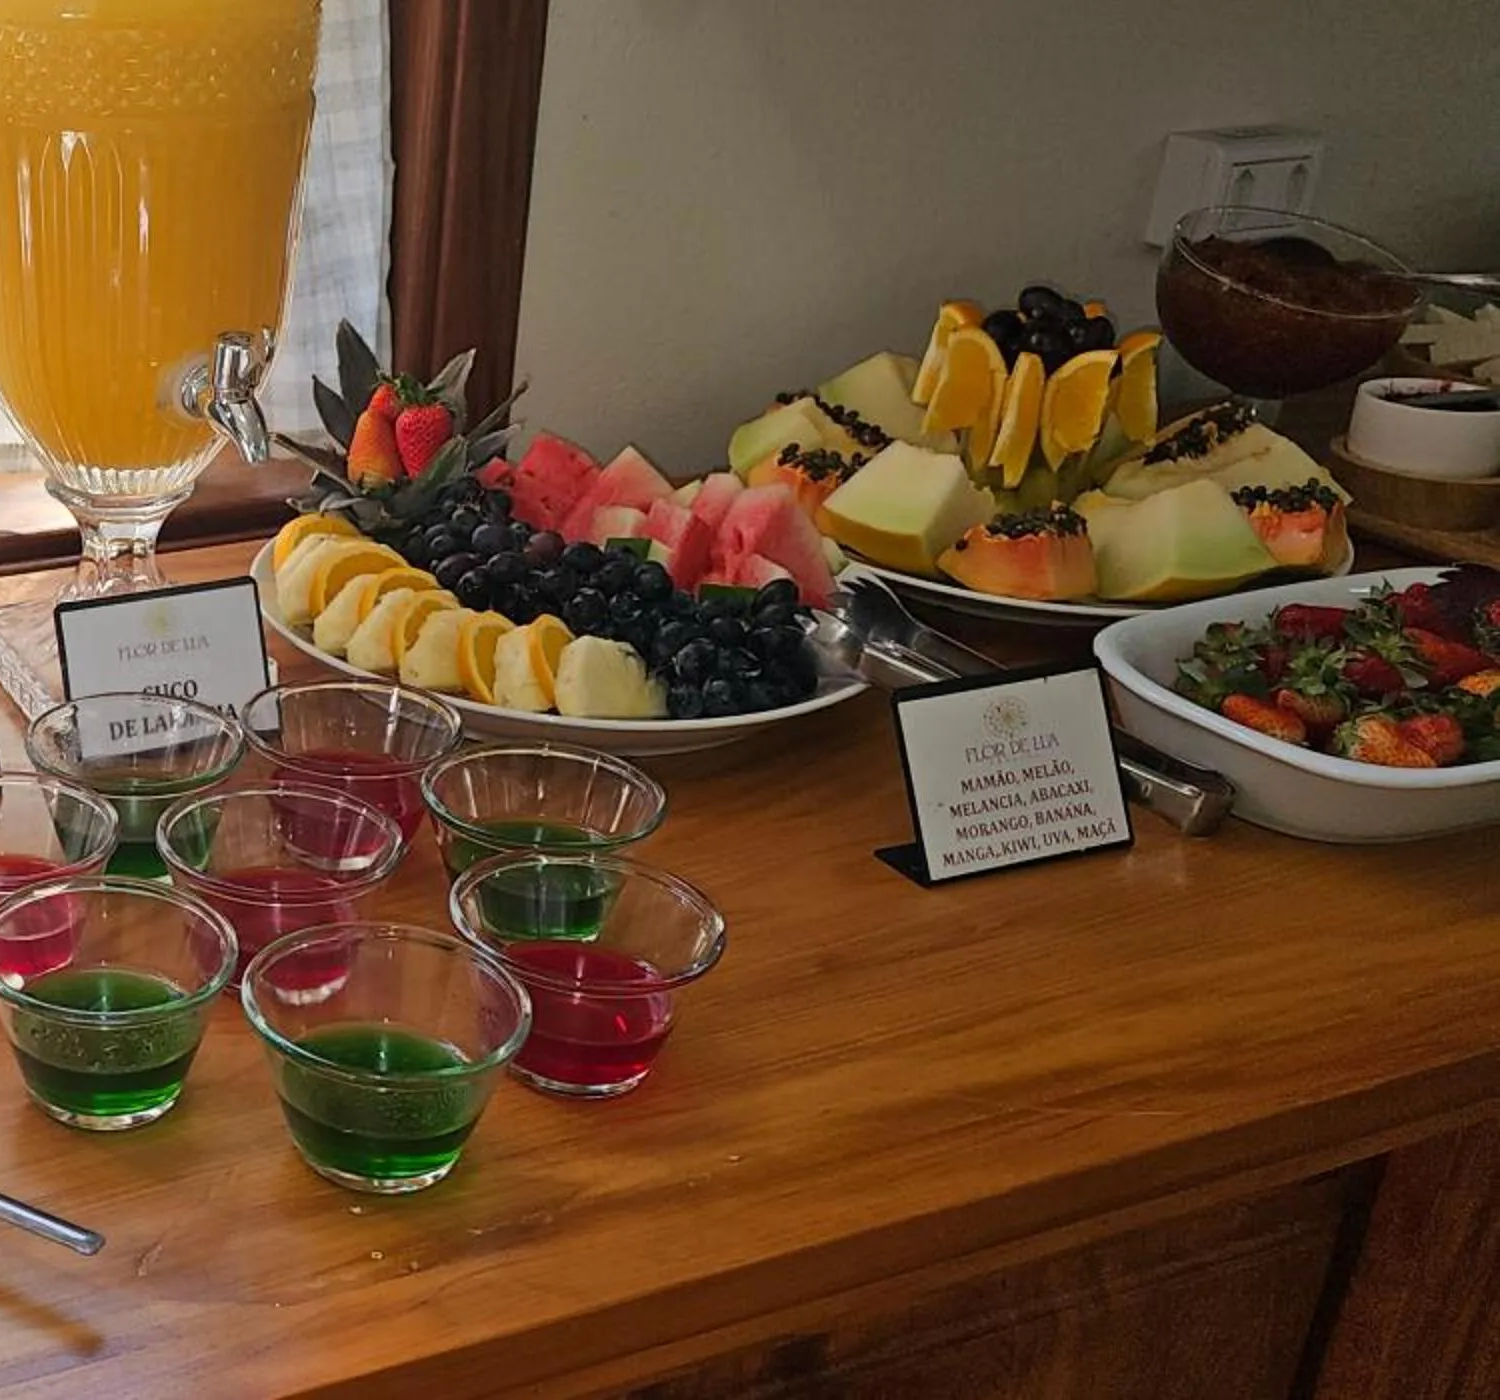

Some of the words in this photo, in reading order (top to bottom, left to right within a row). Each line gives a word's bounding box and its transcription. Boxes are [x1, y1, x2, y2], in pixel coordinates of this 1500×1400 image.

[109, 718, 138, 741] DE
[965, 742, 1005, 764] FLOR
[1009, 737, 1030, 755] DE
[1032, 733, 1060, 751] LUA
[961, 769, 1020, 794] MAMÃO,
[1022, 760, 1075, 783] MELÃO,
[949, 792, 1027, 818] MELANCIA,
[955, 815, 1033, 840] MORANGO,
[1043, 829, 1075, 848] UVA,
[1077, 817, 1116, 840] MAÇÃ
